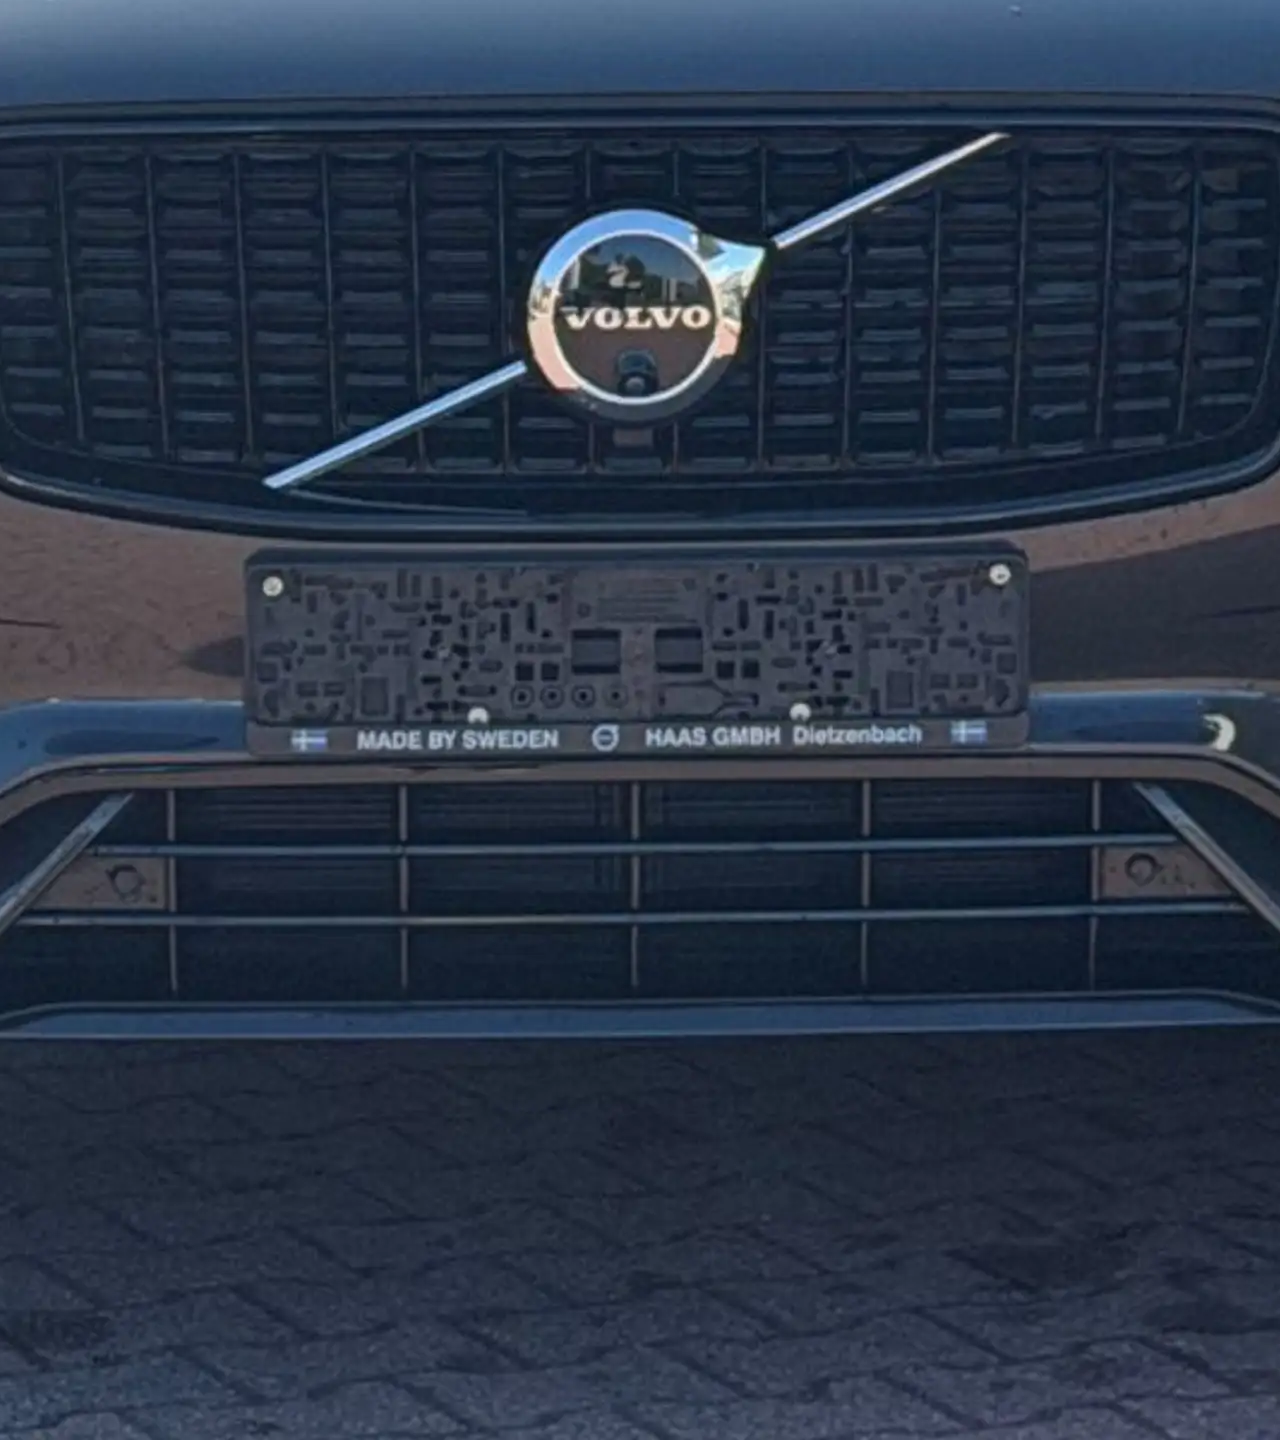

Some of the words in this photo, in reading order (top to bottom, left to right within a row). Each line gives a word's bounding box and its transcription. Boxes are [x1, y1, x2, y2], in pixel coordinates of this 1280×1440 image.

[560, 305, 712, 330] VOLVO
[357, 730, 422, 750] MADE
[428, 730, 456, 750] BY
[462, 729, 559, 750] SWEDEN
[645, 727, 707, 748] HAAS
[712, 726, 782, 747] GMBH
[792, 724, 924, 745] Dietzenbach
